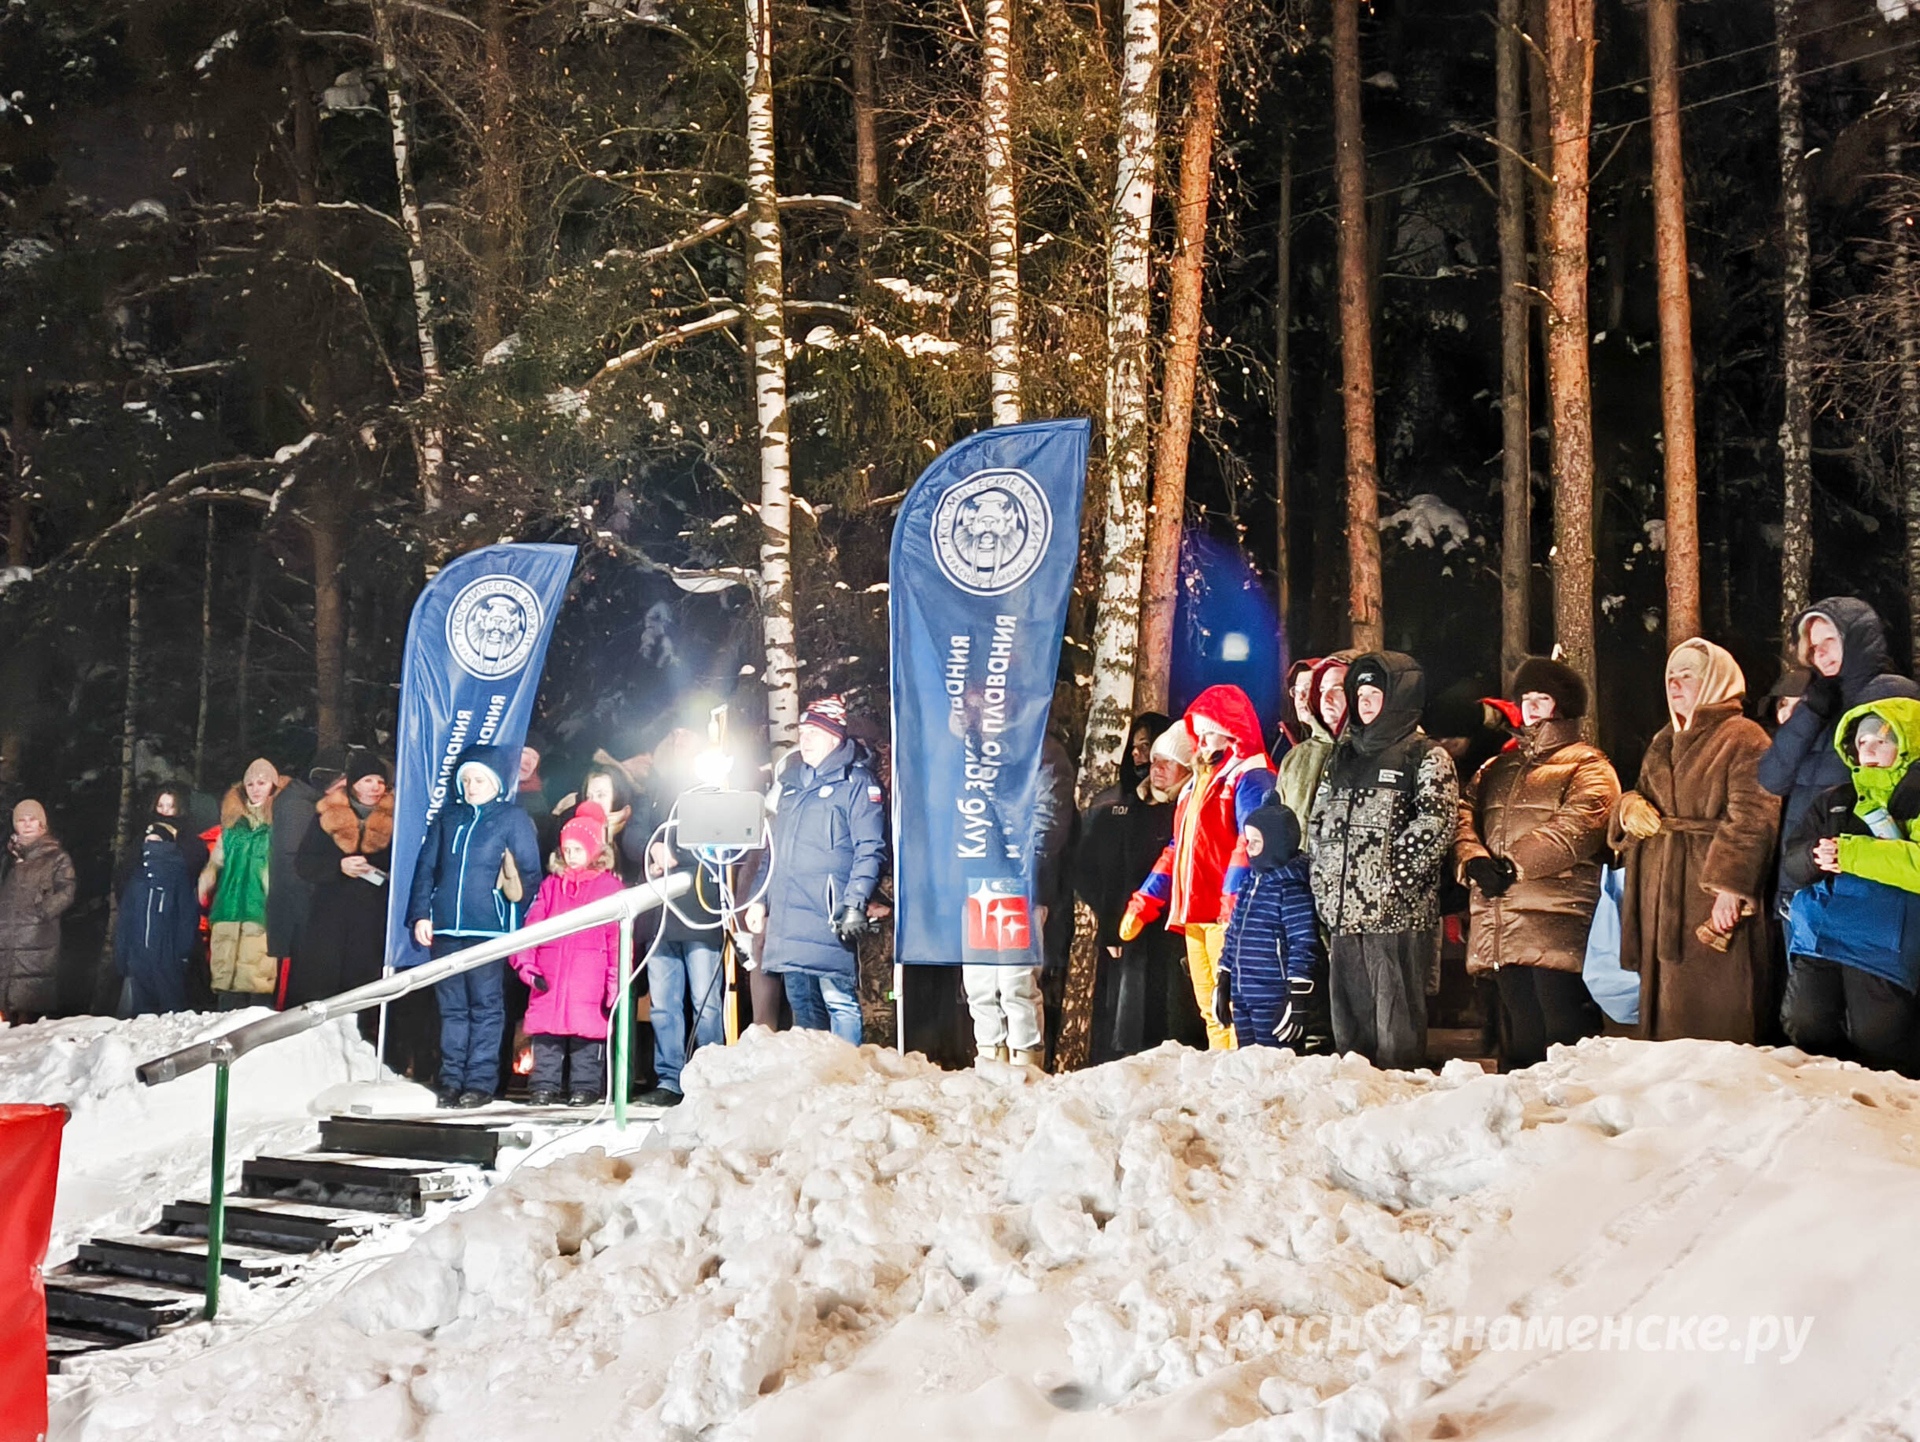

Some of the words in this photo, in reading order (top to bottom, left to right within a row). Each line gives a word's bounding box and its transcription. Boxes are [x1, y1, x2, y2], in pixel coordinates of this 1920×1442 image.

[454, 581, 522, 631] КОСМИЧЕСКИЕ
[982, 614, 1018, 733] плавания
[425, 709, 473, 826] акаливания
[956, 797, 993, 859] Клуб
